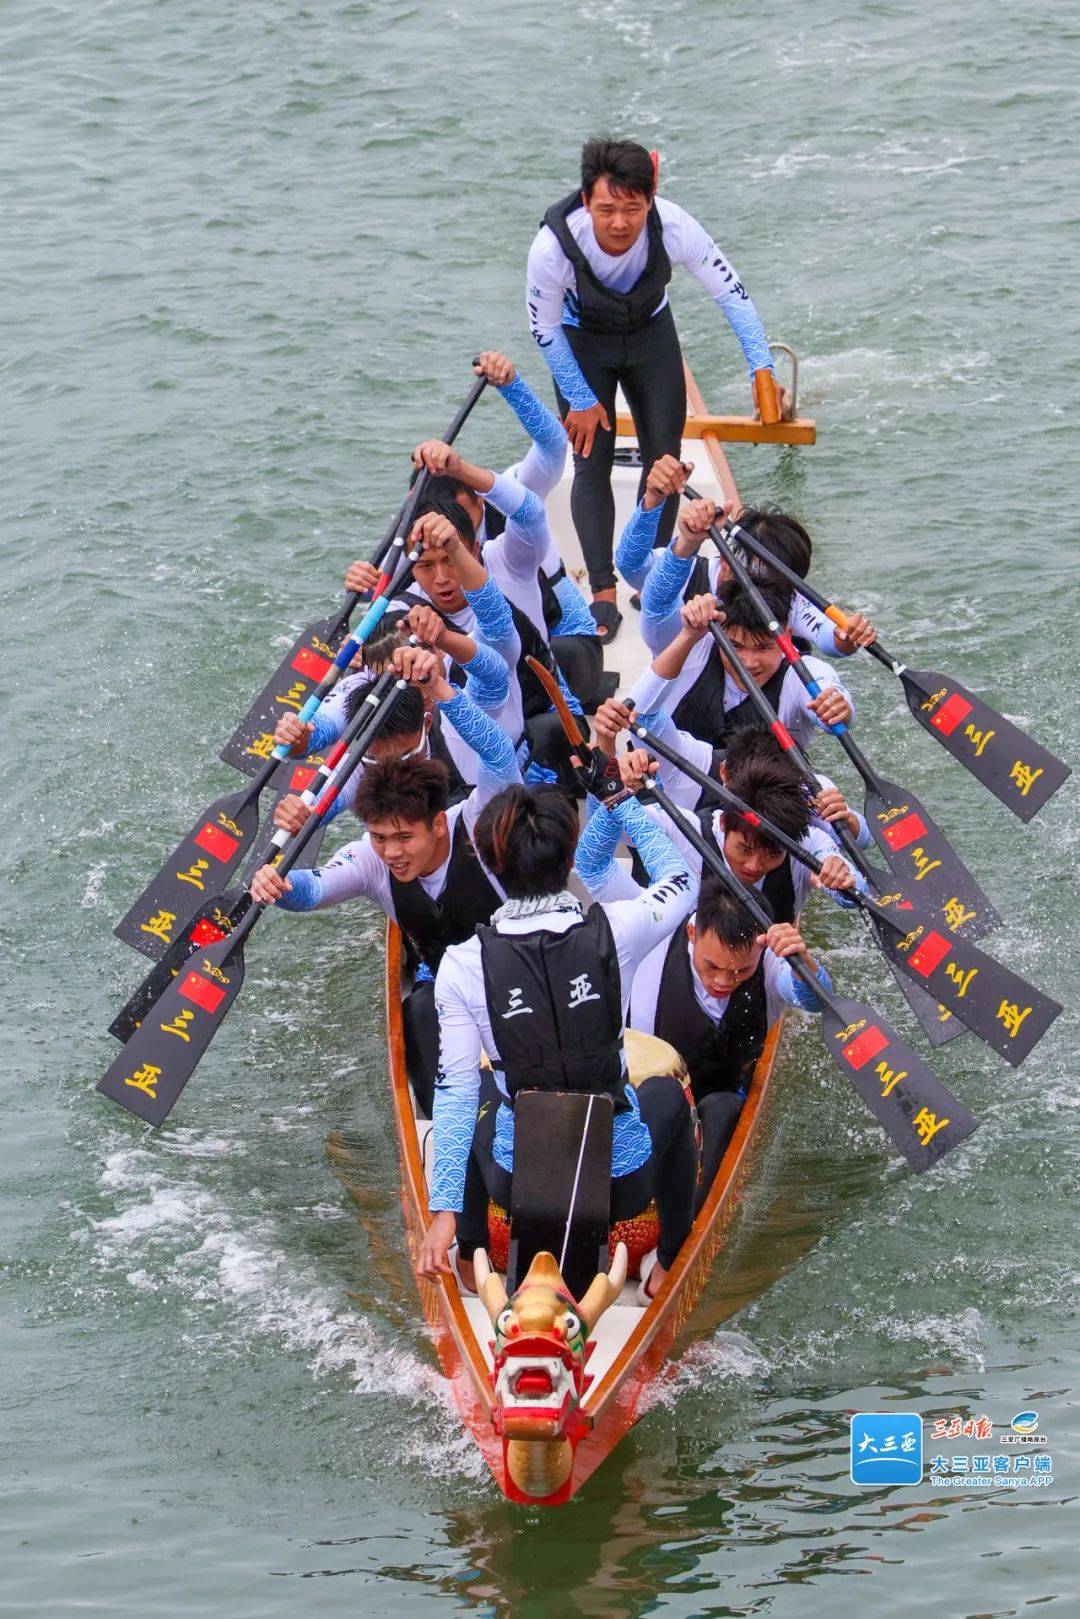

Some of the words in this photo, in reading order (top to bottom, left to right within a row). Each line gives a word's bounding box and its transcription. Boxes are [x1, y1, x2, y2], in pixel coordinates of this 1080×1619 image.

[964, 722, 1044, 797] 三亚
[141, 858, 209, 944] 三亚
[912, 845, 976, 932] 三亚
[501, 973, 600, 1019] 三亚
[945, 961, 1033, 1038] 三亚
[124, 1008, 195, 1100] 三亚
[874, 1060, 950, 1147] 三亚
